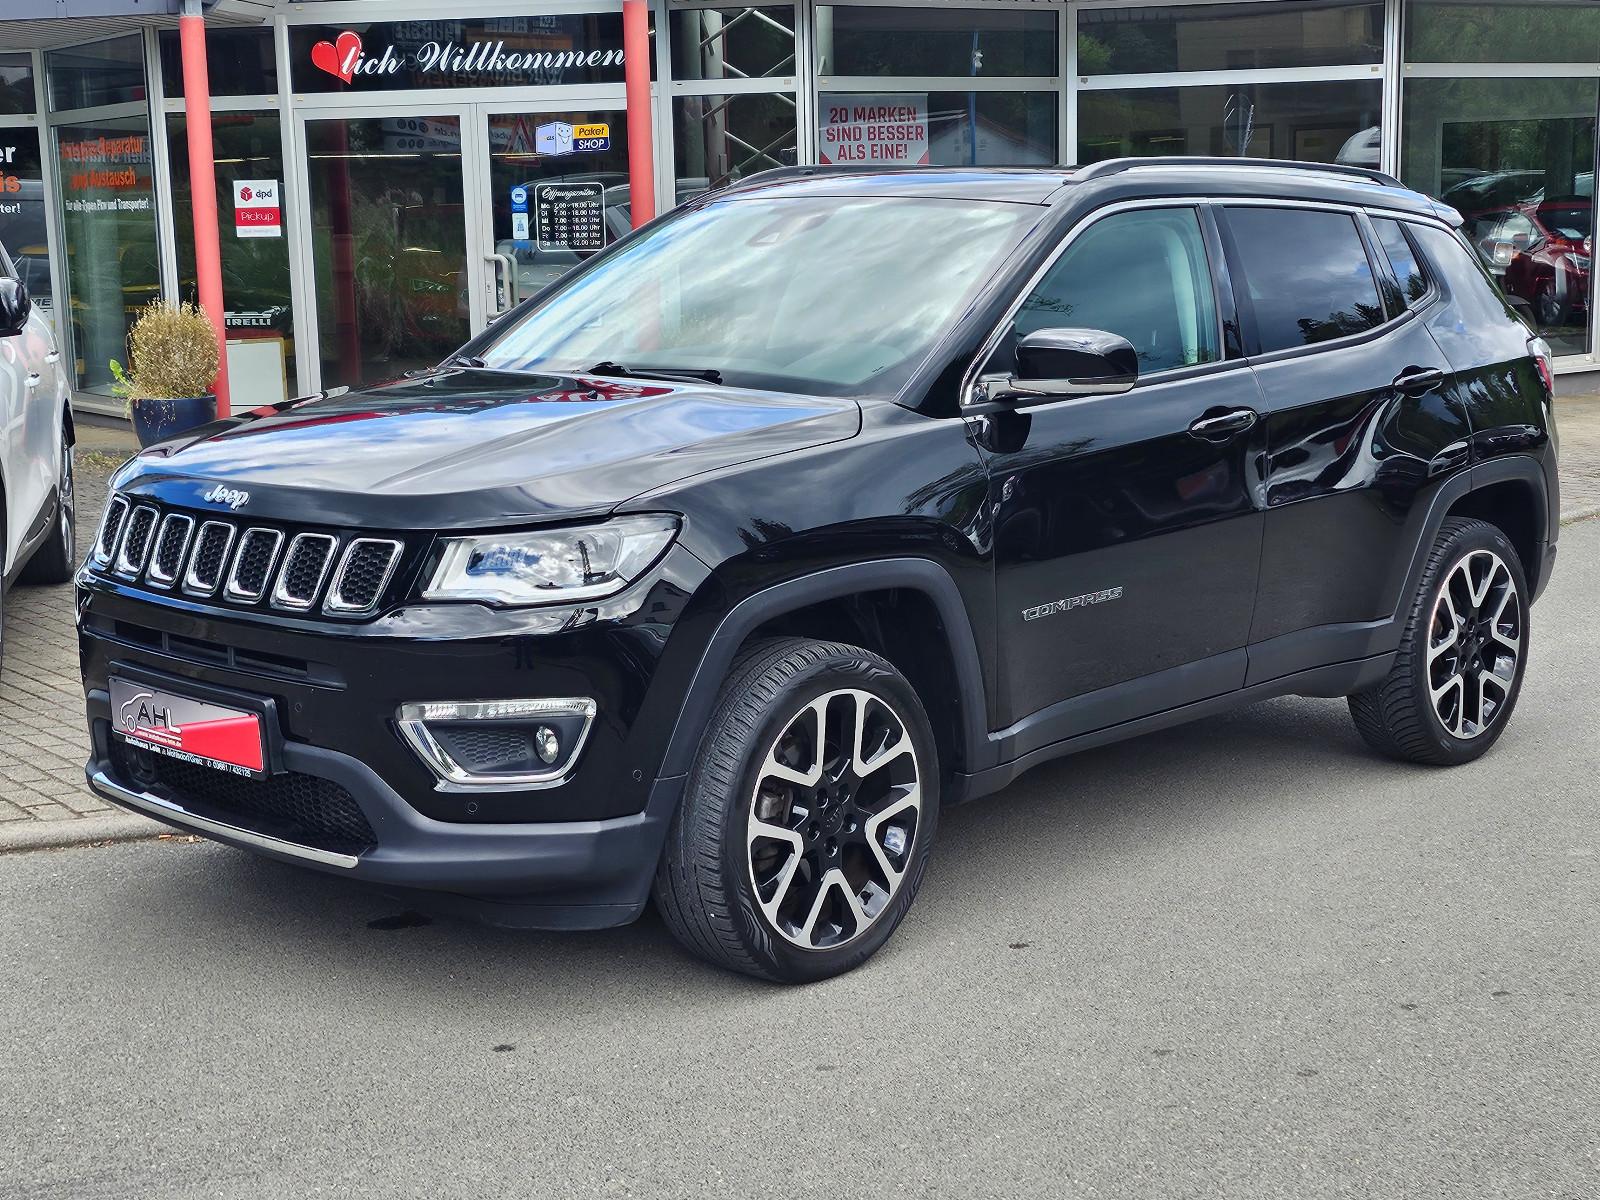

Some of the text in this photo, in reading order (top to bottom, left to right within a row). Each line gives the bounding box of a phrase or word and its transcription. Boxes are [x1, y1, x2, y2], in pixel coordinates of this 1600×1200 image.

[341, 45, 405, 75] lich
[417, 40, 625, 73] Willkommen
[830, 107, 917, 123] 20 MARKEN
[578, 127, 605, 136] Paket
[826, 125, 924, 142] SIND BESSER
[578, 139, 605, 149] SHOP
[837, 143, 908, 161] ALS EINE!
[90, 167, 137, 188] Austausch
[255, 188, 272, 199] dpd
[241, 211, 275, 221] Pickup
[224, 318, 271, 326] IRELLI
[204, 484, 250, 511] Jeep
[1022, 586, 1123, 621] COMPASS
[137, 700, 182, 734] AHL
